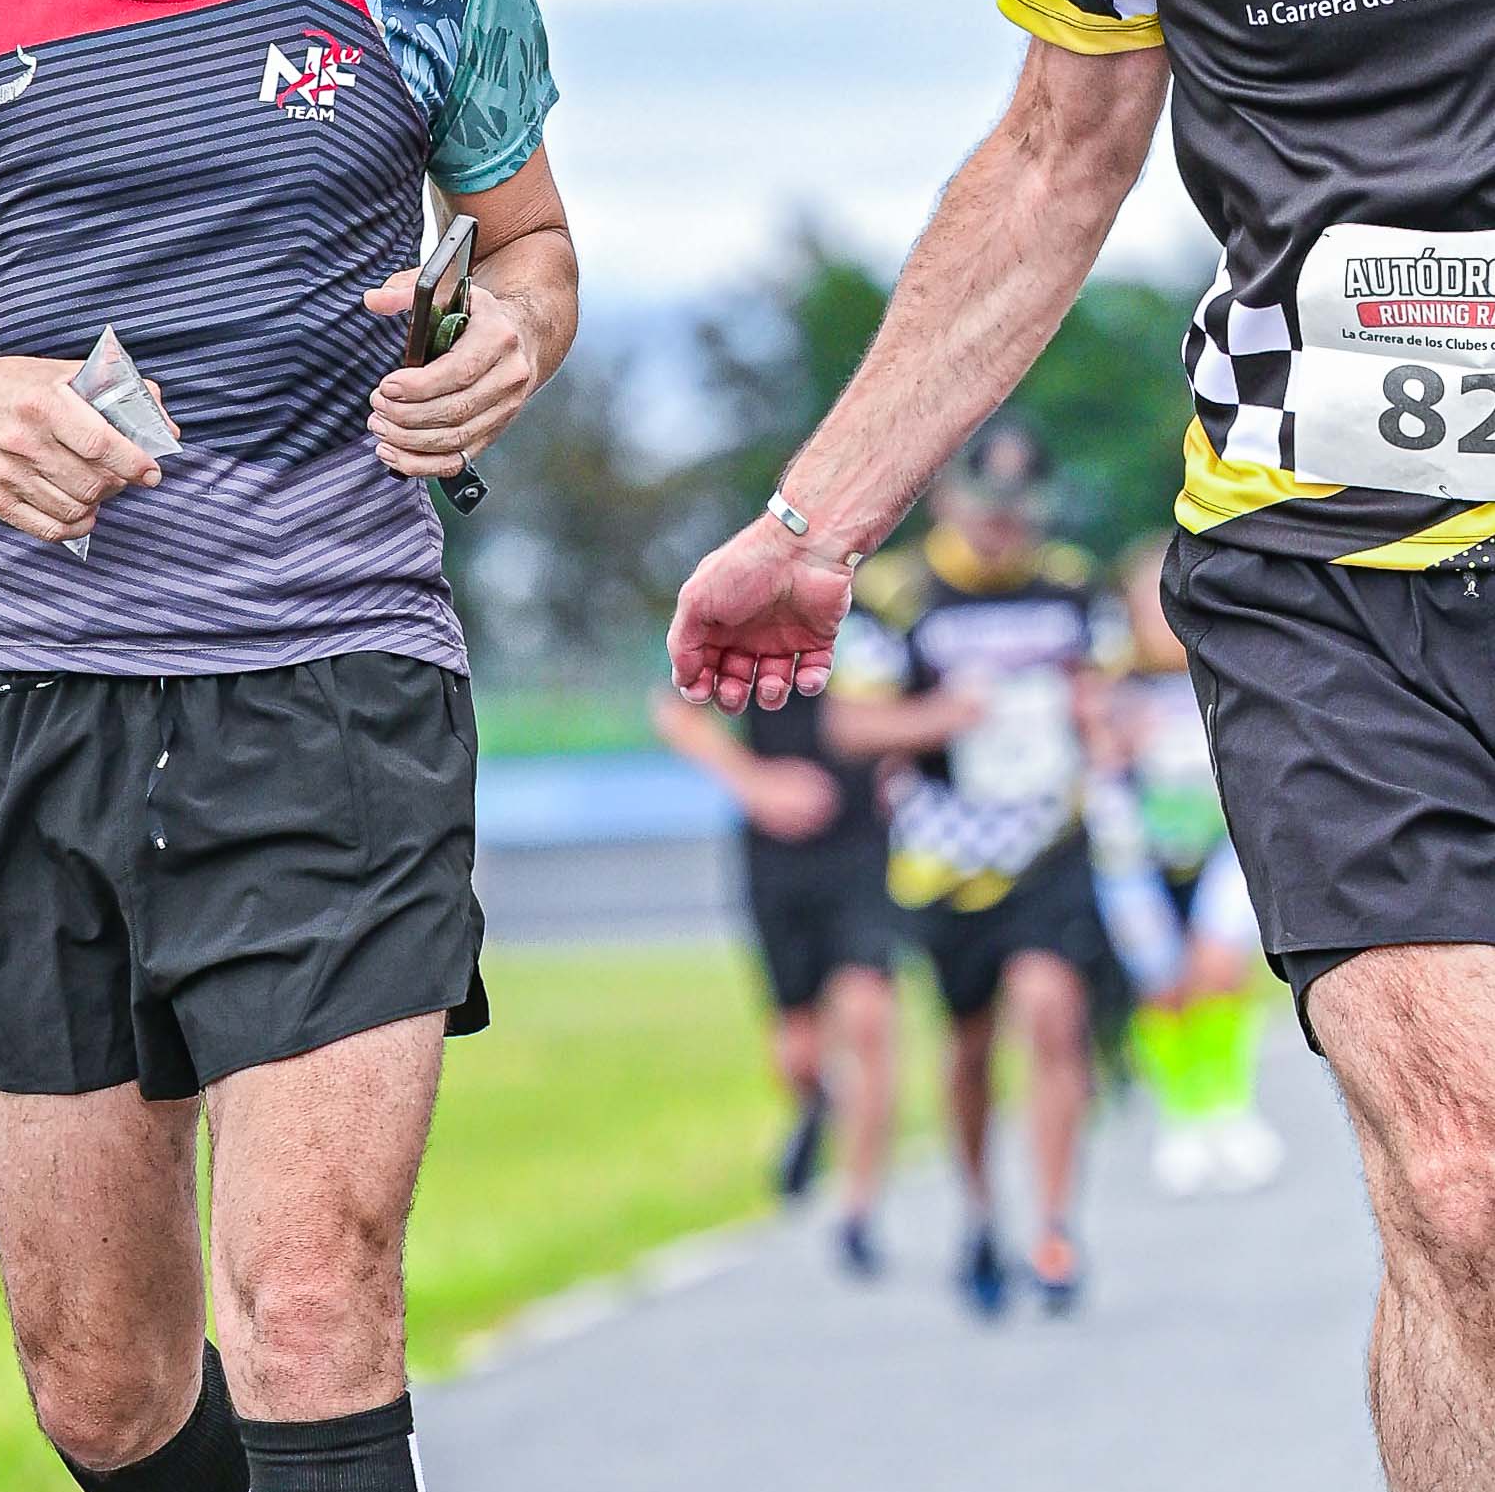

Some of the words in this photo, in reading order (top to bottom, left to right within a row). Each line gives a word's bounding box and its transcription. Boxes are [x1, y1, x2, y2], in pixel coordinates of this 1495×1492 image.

[1246, 4, 1269, 25] La
[285, 105, 335, 122] TEAM
[1379, 304, 1470, 326] RUNNING
[1342, 328, 1355, 339] La
[1359, 331, 1403, 345] Carrera
[1407, 335, 1422, 346] de
[1425, 336, 1442, 348] los
[1446, 338, 1488, 351] Clubes
